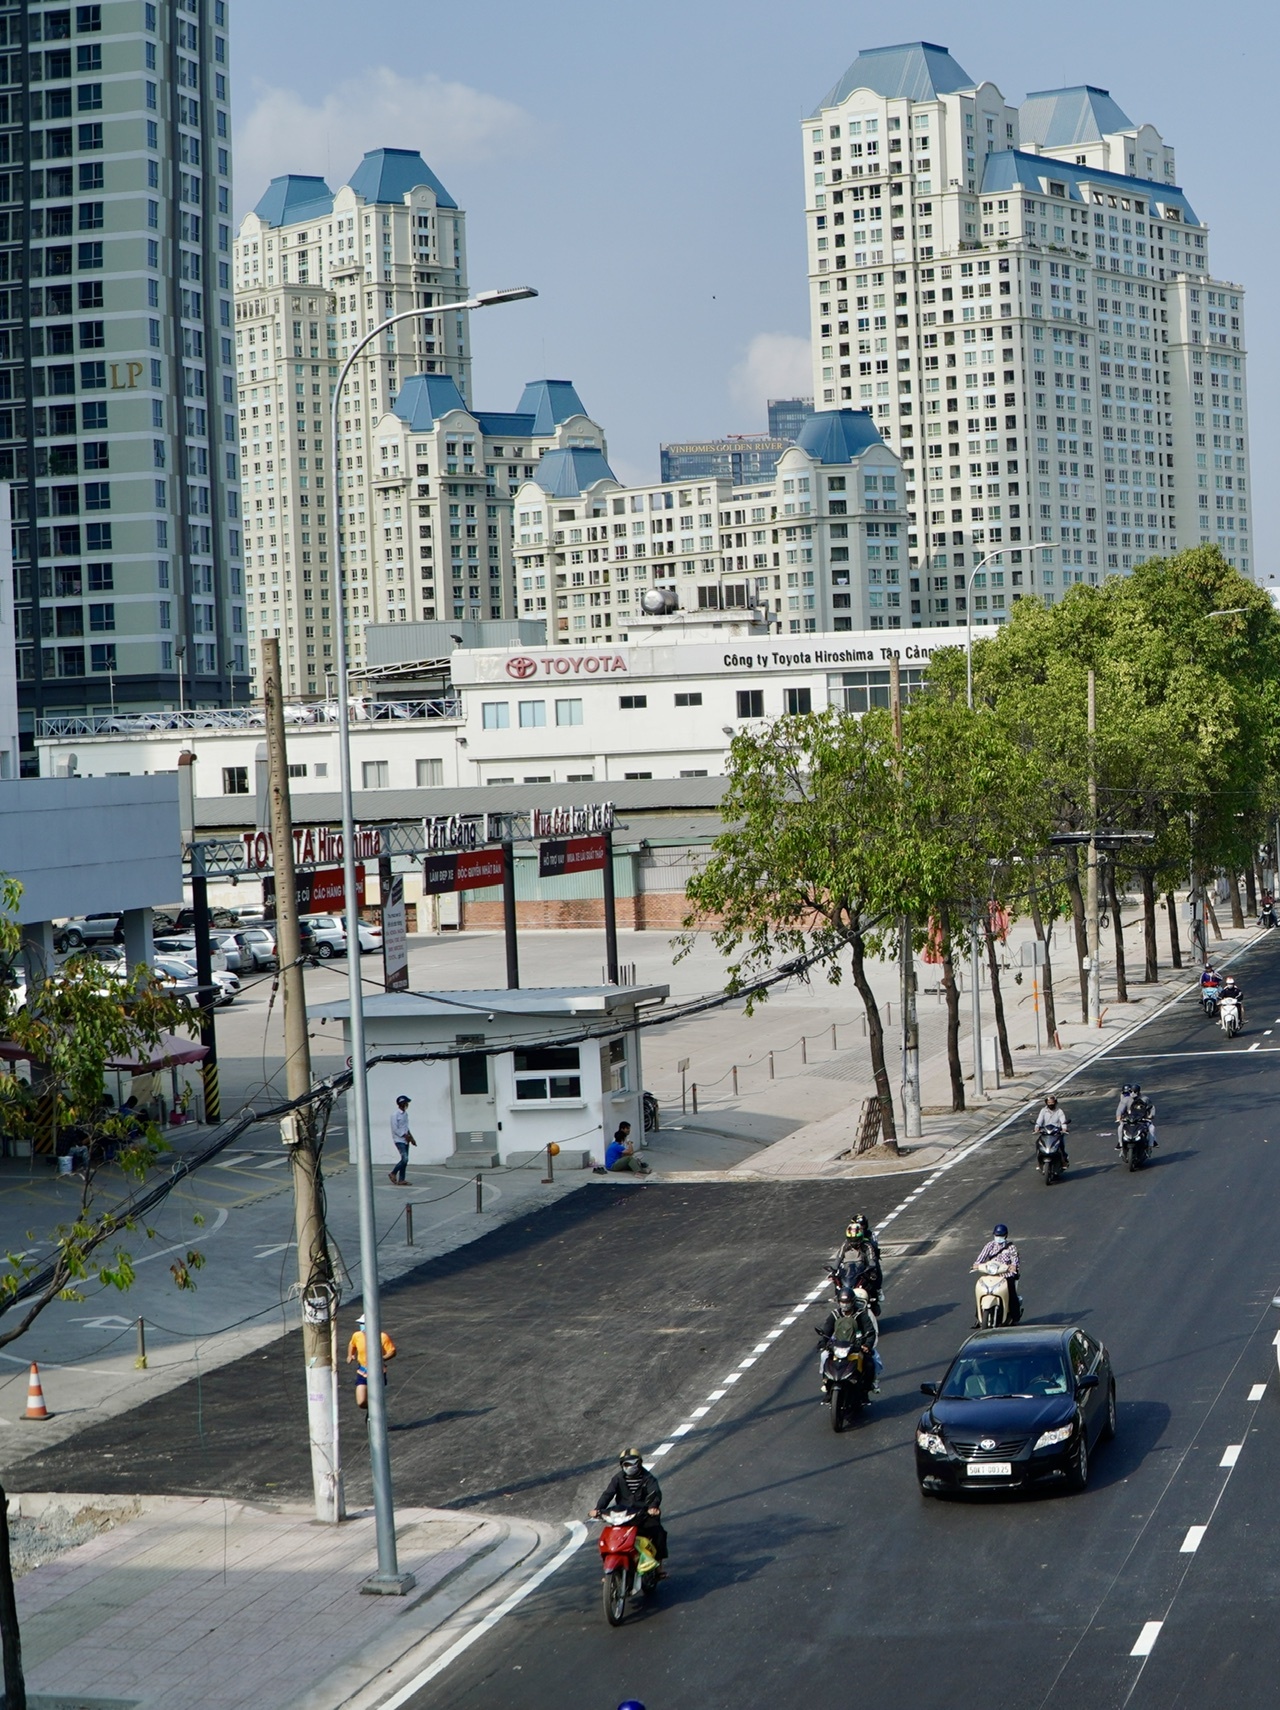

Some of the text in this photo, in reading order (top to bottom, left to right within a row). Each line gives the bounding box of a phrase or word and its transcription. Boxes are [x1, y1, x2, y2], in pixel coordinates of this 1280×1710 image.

[541, 655, 627, 675] TOYOTA
[724, 652, 753, 668] Công
[757, 653, 769, 668] ty
[773, 651, 811, 666] Toyota
[815, 649, 874, 663] Hiroshima
[240, 829, 315, 869] TOTA
[313, 884, 326, 900] CÁC
[326, 882, 342, 898] HÀNG
